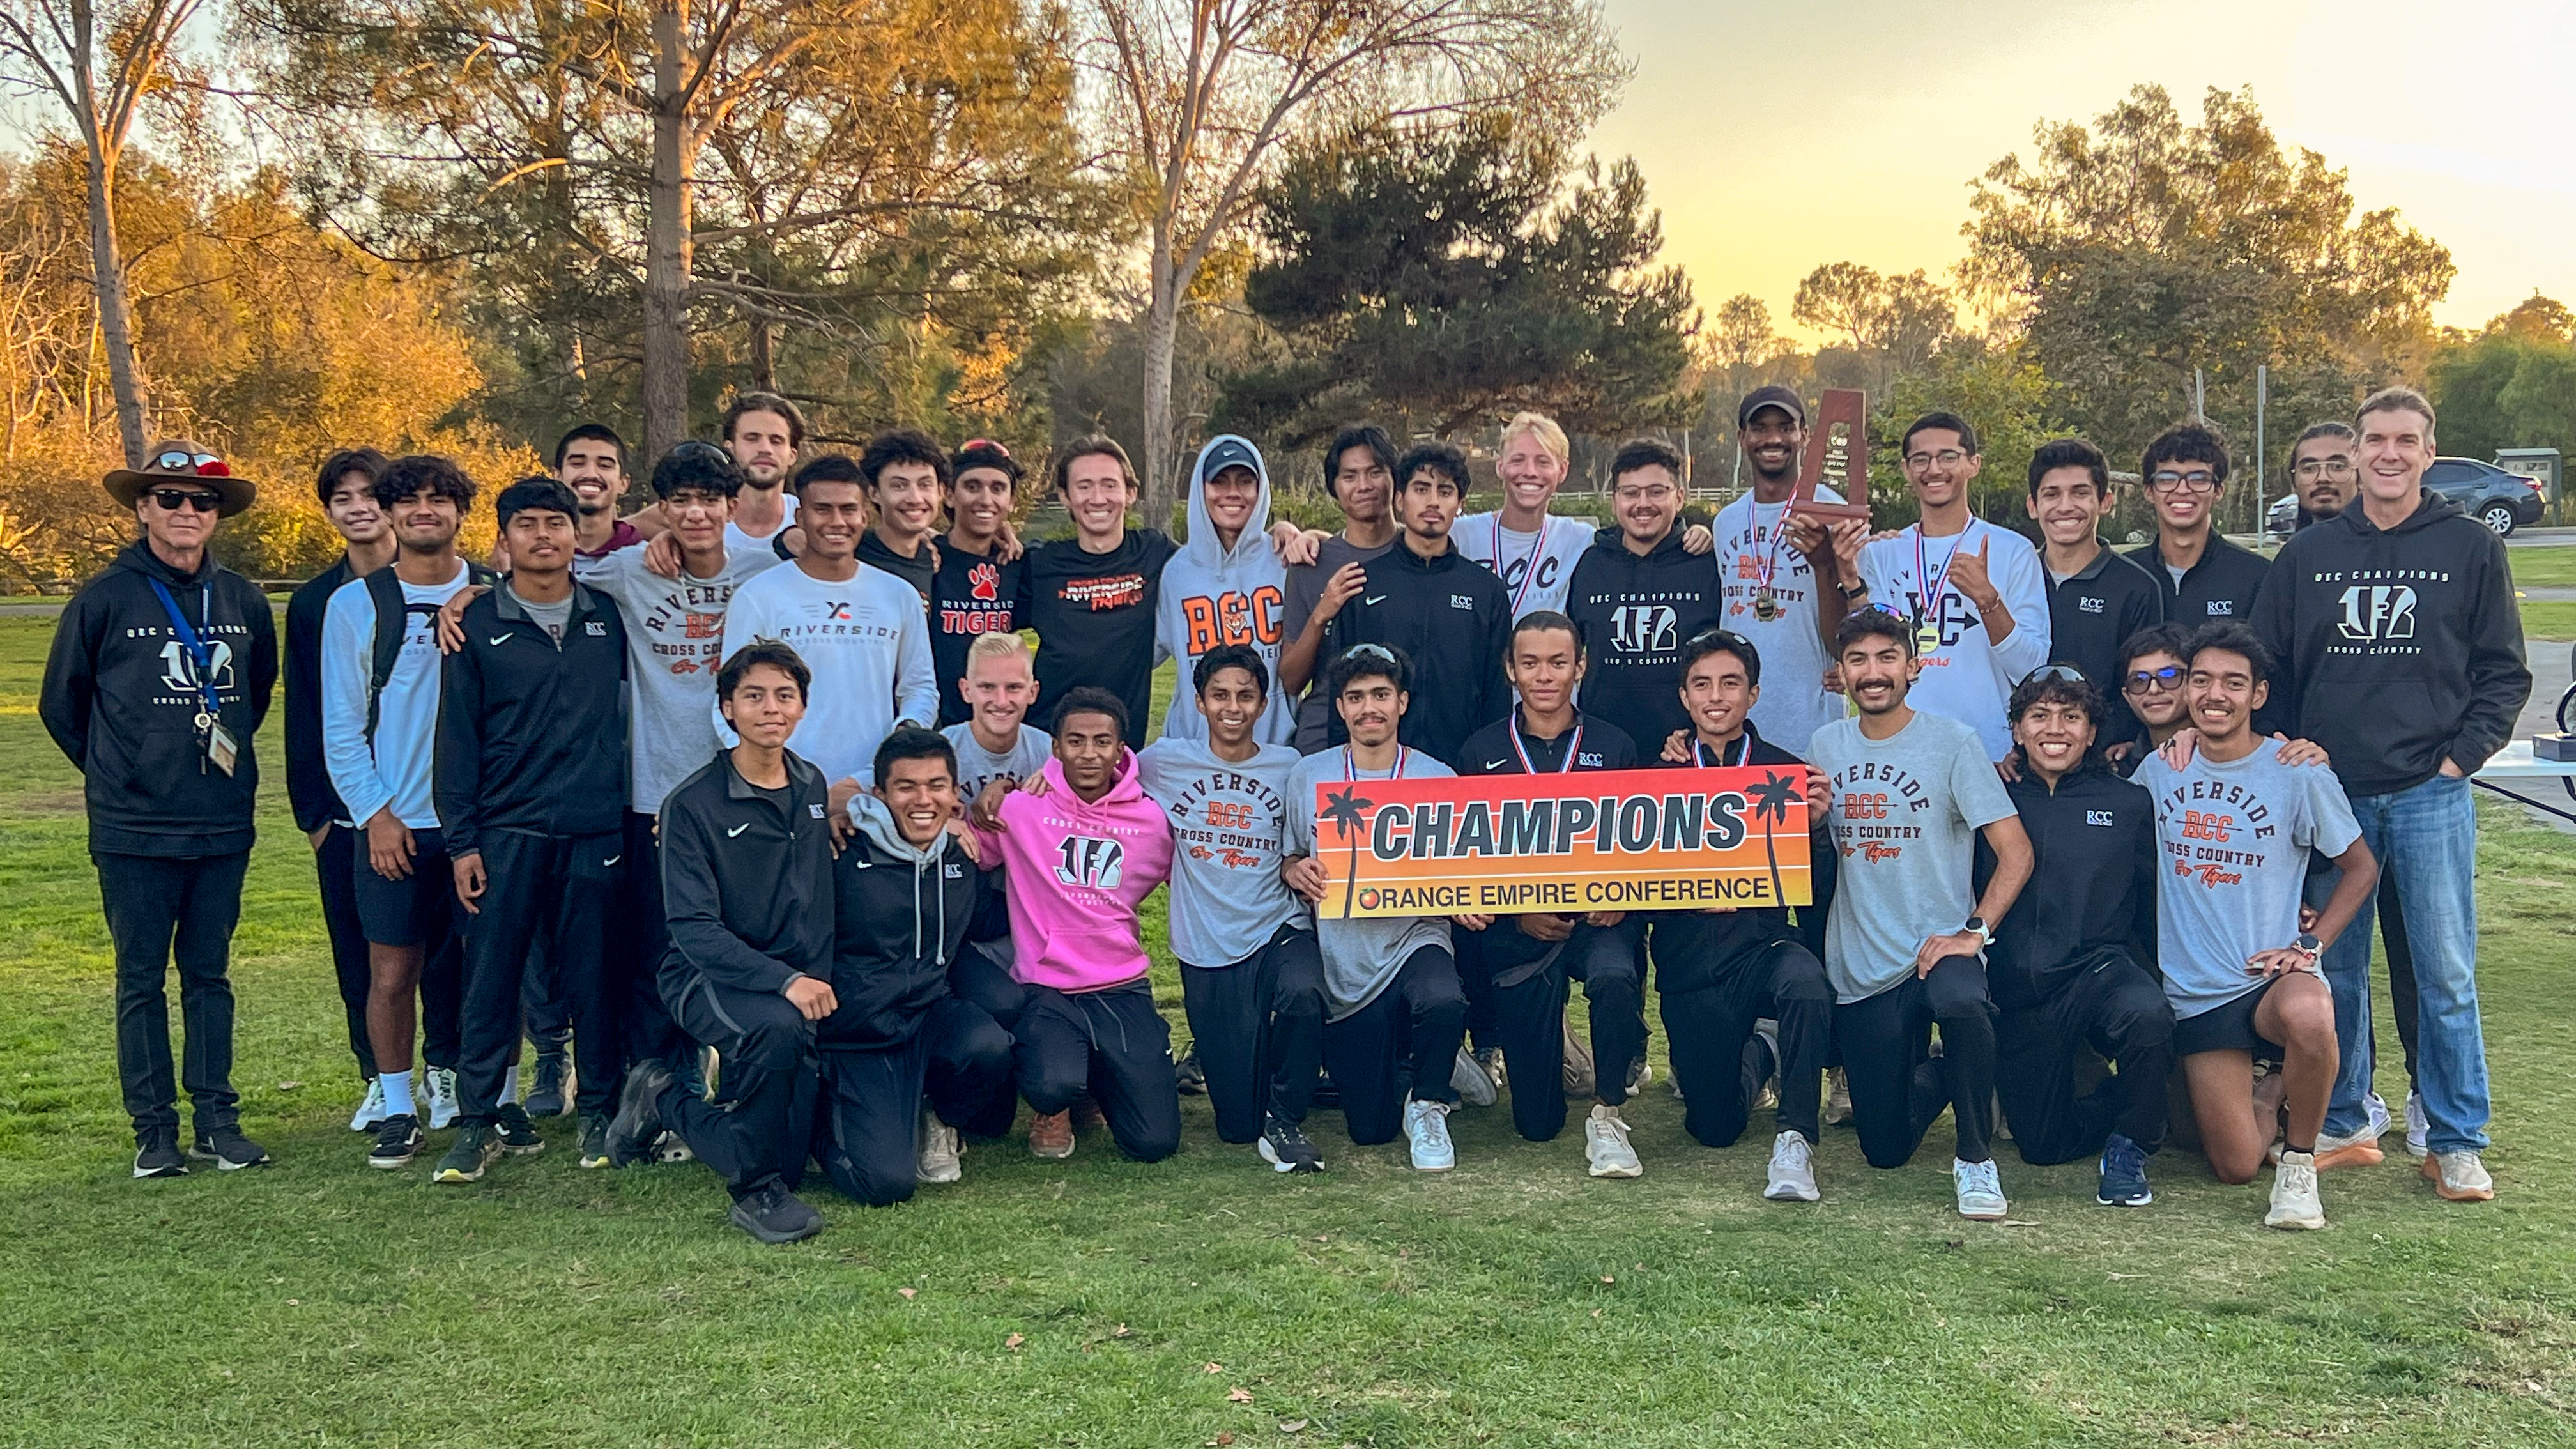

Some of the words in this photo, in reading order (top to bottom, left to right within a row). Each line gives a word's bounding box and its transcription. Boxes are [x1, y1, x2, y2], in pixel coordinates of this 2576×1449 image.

[1451, 595, 1473, 606] RCC
[2080, 597, 2105, 608] RCC
[2207, 601, 2232, 611] RCC
[1182, 585, 1284, 656] RCC
[781, 625, 897, 640] RIVERSIDE
[652, 643, 696, 656] CROSS
[1579, 752, 1603, 763] RCC
[1170, 773, 1284, 828] RIVERSIDE
[1845, 793, 1888, 820] RCC
[1206, 801, 1253, 830] RCC
[2086, 810, 2113, 822] RCC
[1372, 792, 1747, 862] CHAMPIONS
[1860, 826, 1922, 838] COUNTRY
[2182, 810, 2234, 843] RCC
[1216, 848, 1261, 869] Tigers
[1857, 840, 1902, 865] Tigers
[2196, 847, 2266, 868] COUNTRY
[2193, 864, 2242, 889] Tigers
[1359, 885, 1471, 910] ORANGE
[1480, 882, 1577, 906] EMPIRE
[1586, 877, 1770, 903] CONFERENCE
